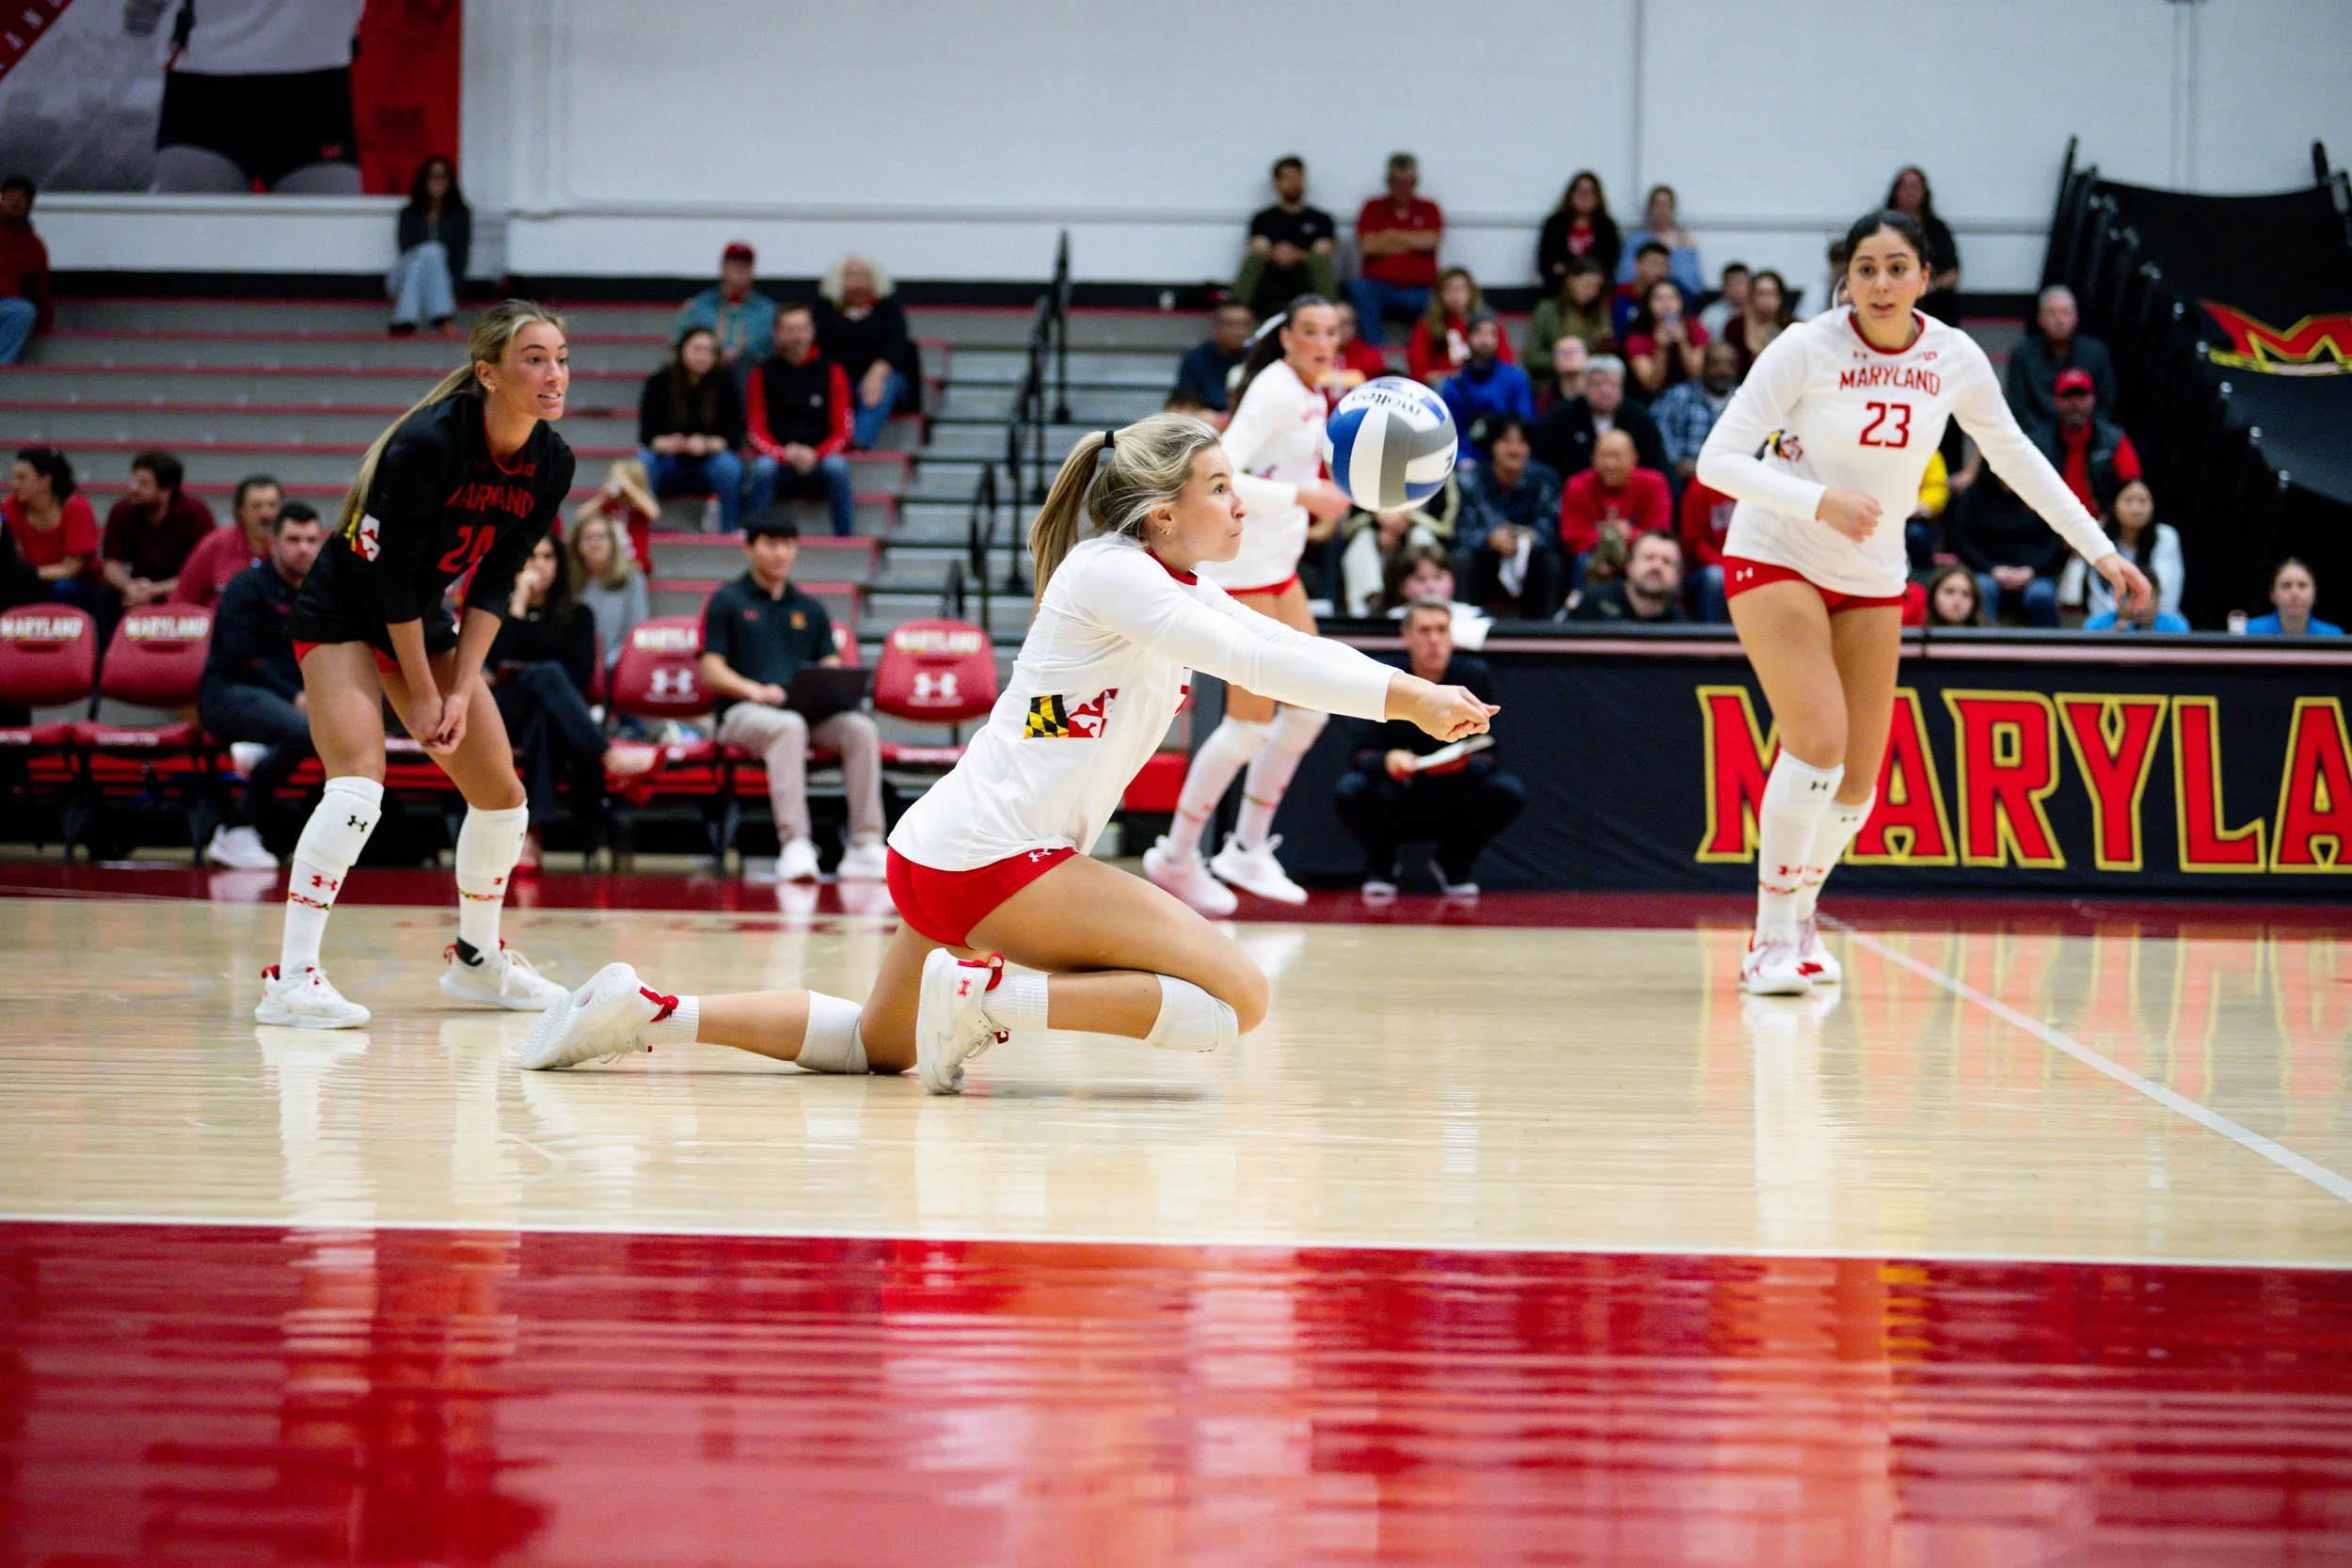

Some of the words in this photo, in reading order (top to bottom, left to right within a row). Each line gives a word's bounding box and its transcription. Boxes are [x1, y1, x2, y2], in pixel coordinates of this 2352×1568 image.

[1839, 365, 1941, 396] MARYLAND
[1351, 391, 1422, 417] molten
[1859, 402, 1911, 449] 23
